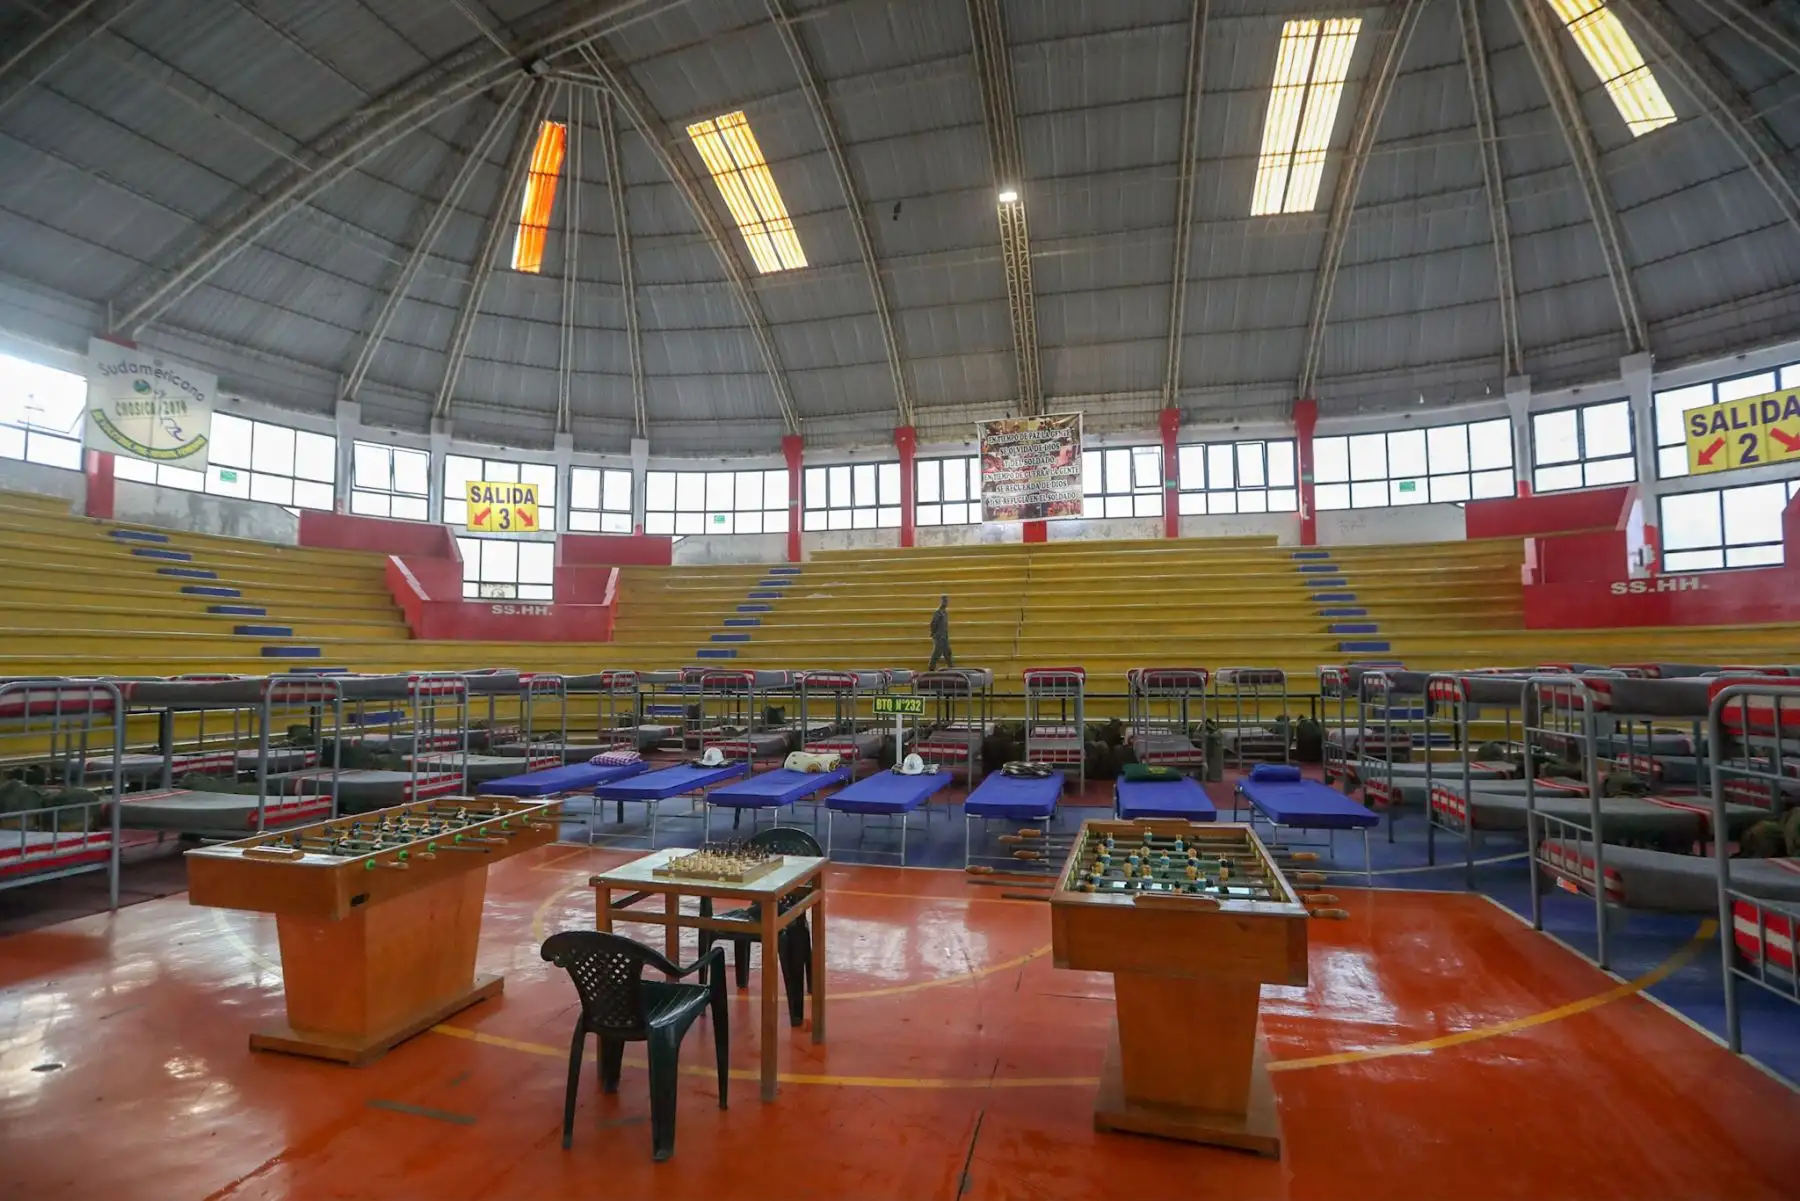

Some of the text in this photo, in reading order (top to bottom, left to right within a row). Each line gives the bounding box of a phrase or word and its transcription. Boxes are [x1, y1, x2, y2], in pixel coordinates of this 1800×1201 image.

[97, 360, 205, 402] Sudamericano
[1690, 395, 1800, 437] SALIDA
[997, 433, 1019, 443] TIEMPO
[1020, 432, 1029, 440] DE
[1029, 431, 1040, 440] PAZ
[1041, 430, 1050, 438] LA
[1050, 429, 1070, 437] GENTE
[1000, 441, 1060, 455] SE OLVIDA DE DIOS
[1738, 432, 1759, 465] 2
[992, 470, 1014, 480] TIEMPO
[1015, 470, 1024, 478] DE
[1024, 468, 1050, 478] GUERRA
[1051, 468, 1059, 476] LA
[1060, 466, 1079, 475] GENTE
[997, 484, 1005, 492] SE
[1005, 481, 1041, 491] RECUERDA
[1041, 481, 1051, 489] DE
[470, 485, 536, 505] SALIDA
[1048, 491, 1076, 501] SOLDADO
[498, 508, 511, 530] 3
[1611, 576, 1711, 595] SS.HH.
[491, 604, 553, 616] SS.HH.
